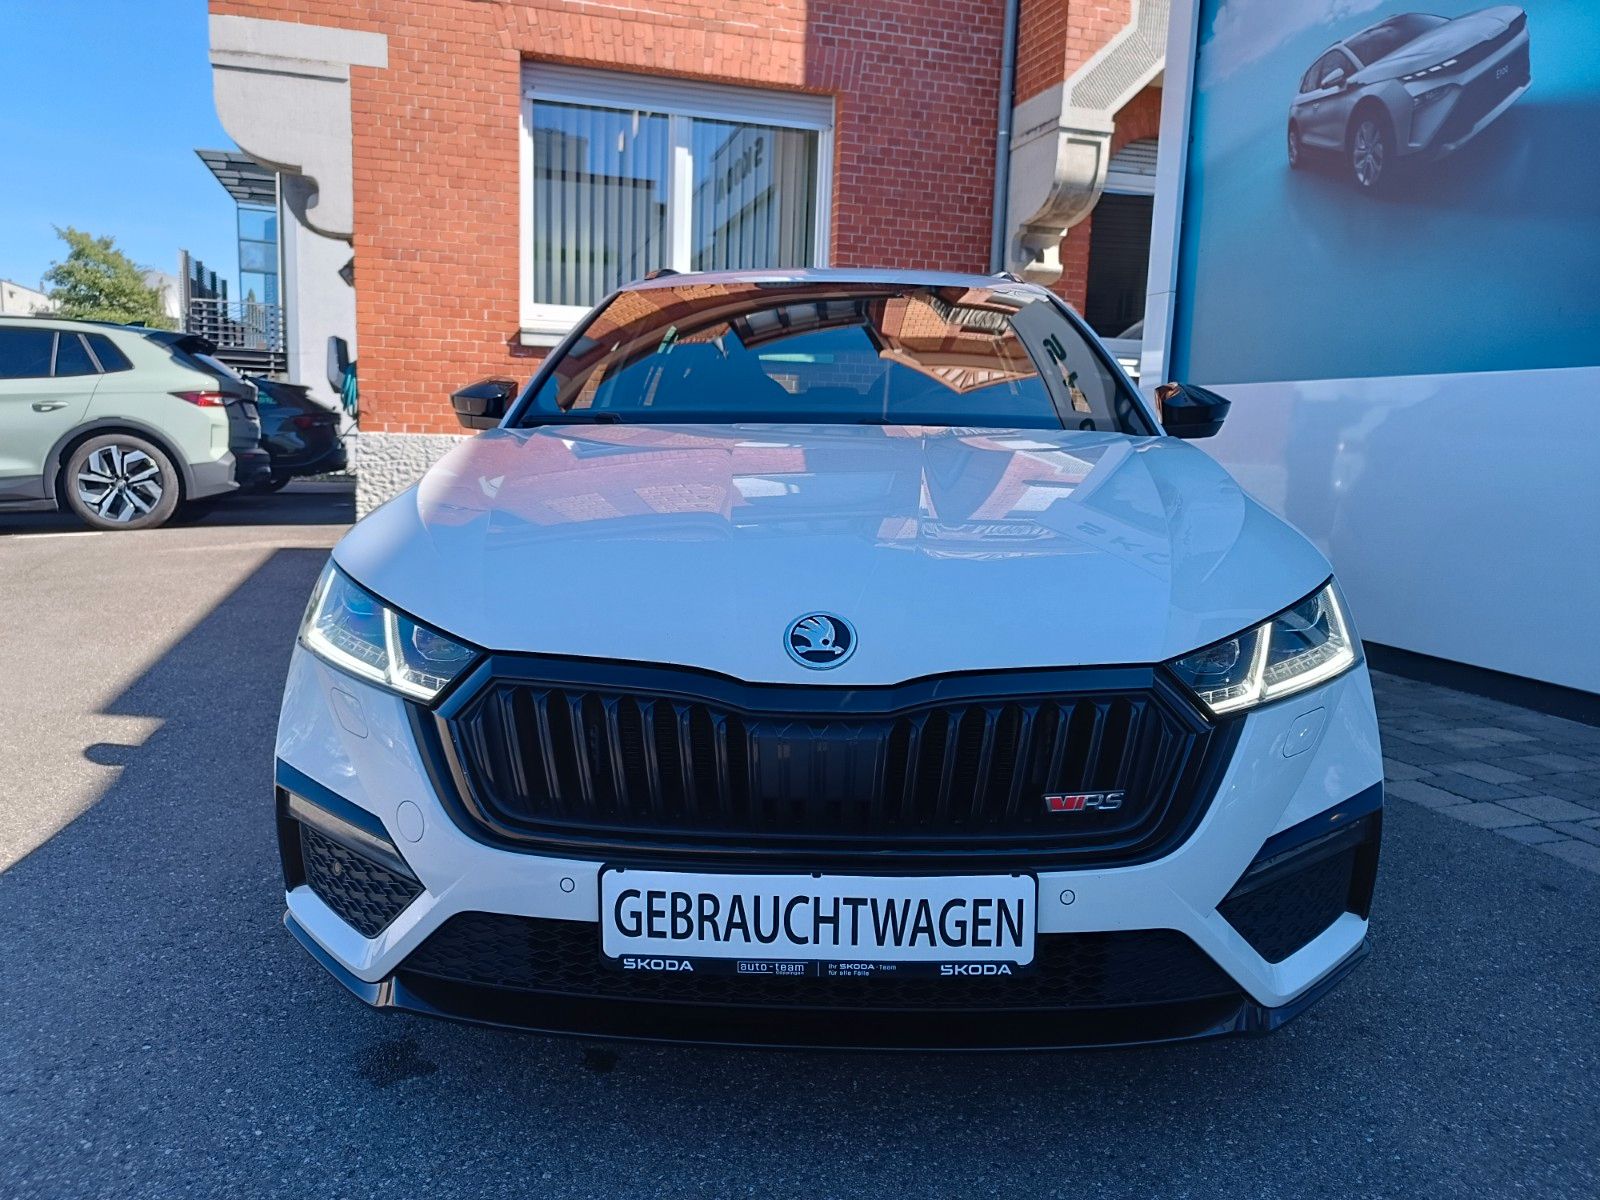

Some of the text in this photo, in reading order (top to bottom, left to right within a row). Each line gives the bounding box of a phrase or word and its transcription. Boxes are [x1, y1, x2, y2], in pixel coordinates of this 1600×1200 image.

[614, 889, 1024, 948] GEBRAUCHTWAGEN
[623, 958, 694, 971] SKODA
[940, 964, 1012, 975] SKODA
